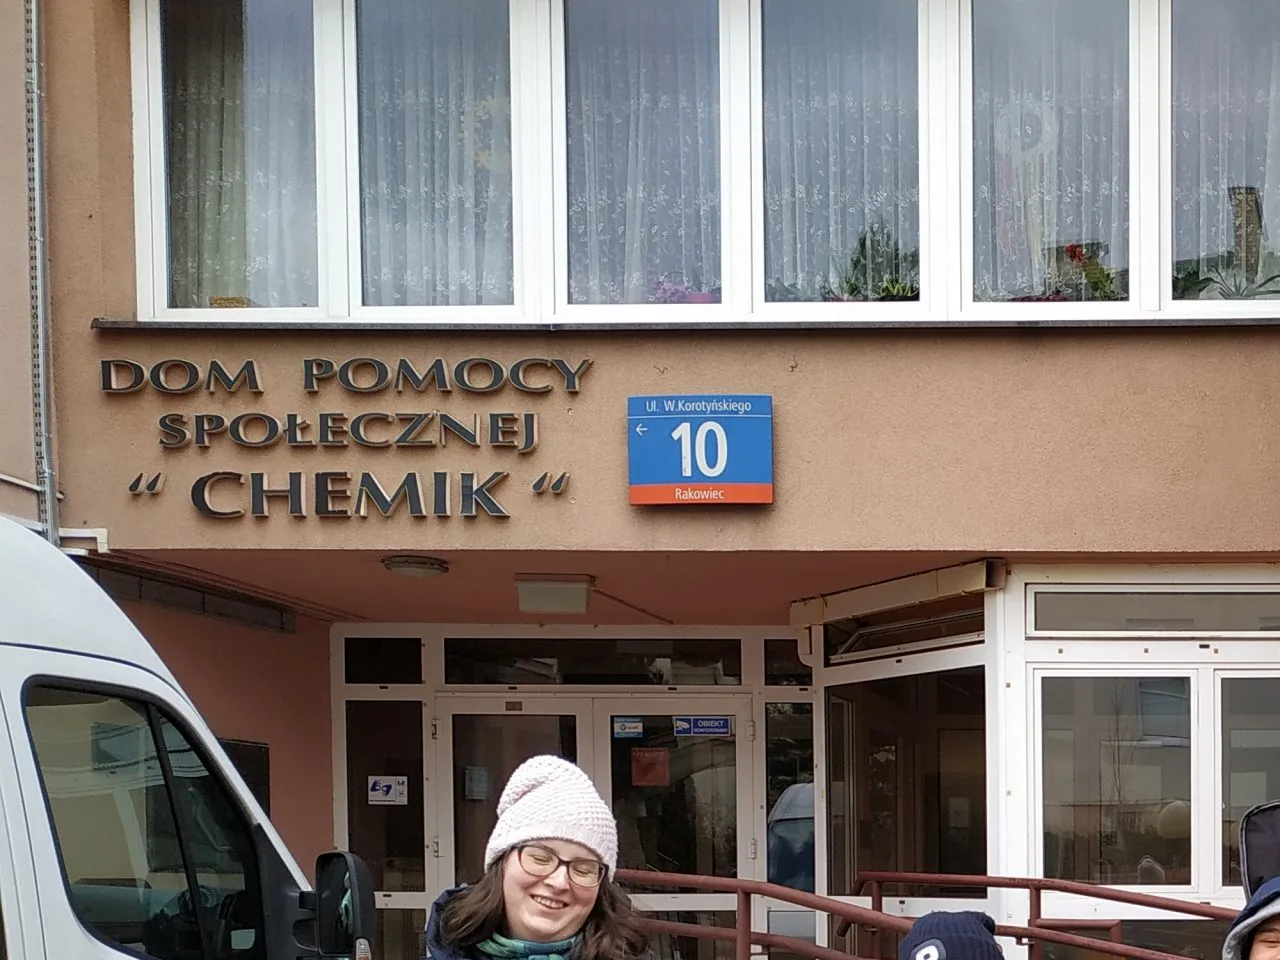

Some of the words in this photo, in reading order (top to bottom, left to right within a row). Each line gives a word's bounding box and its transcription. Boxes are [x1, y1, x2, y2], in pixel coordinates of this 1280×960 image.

[100, 358, 264, 394] DOM
[303, 357, 593, 394] POMOCY
[646, 400, 659, 412] Ul.
[158, 411, 538, 454] SPOŁECZNEJ
[671, 420, 728, 477] 10
[675, 488, 725, 500] Rakowiec
